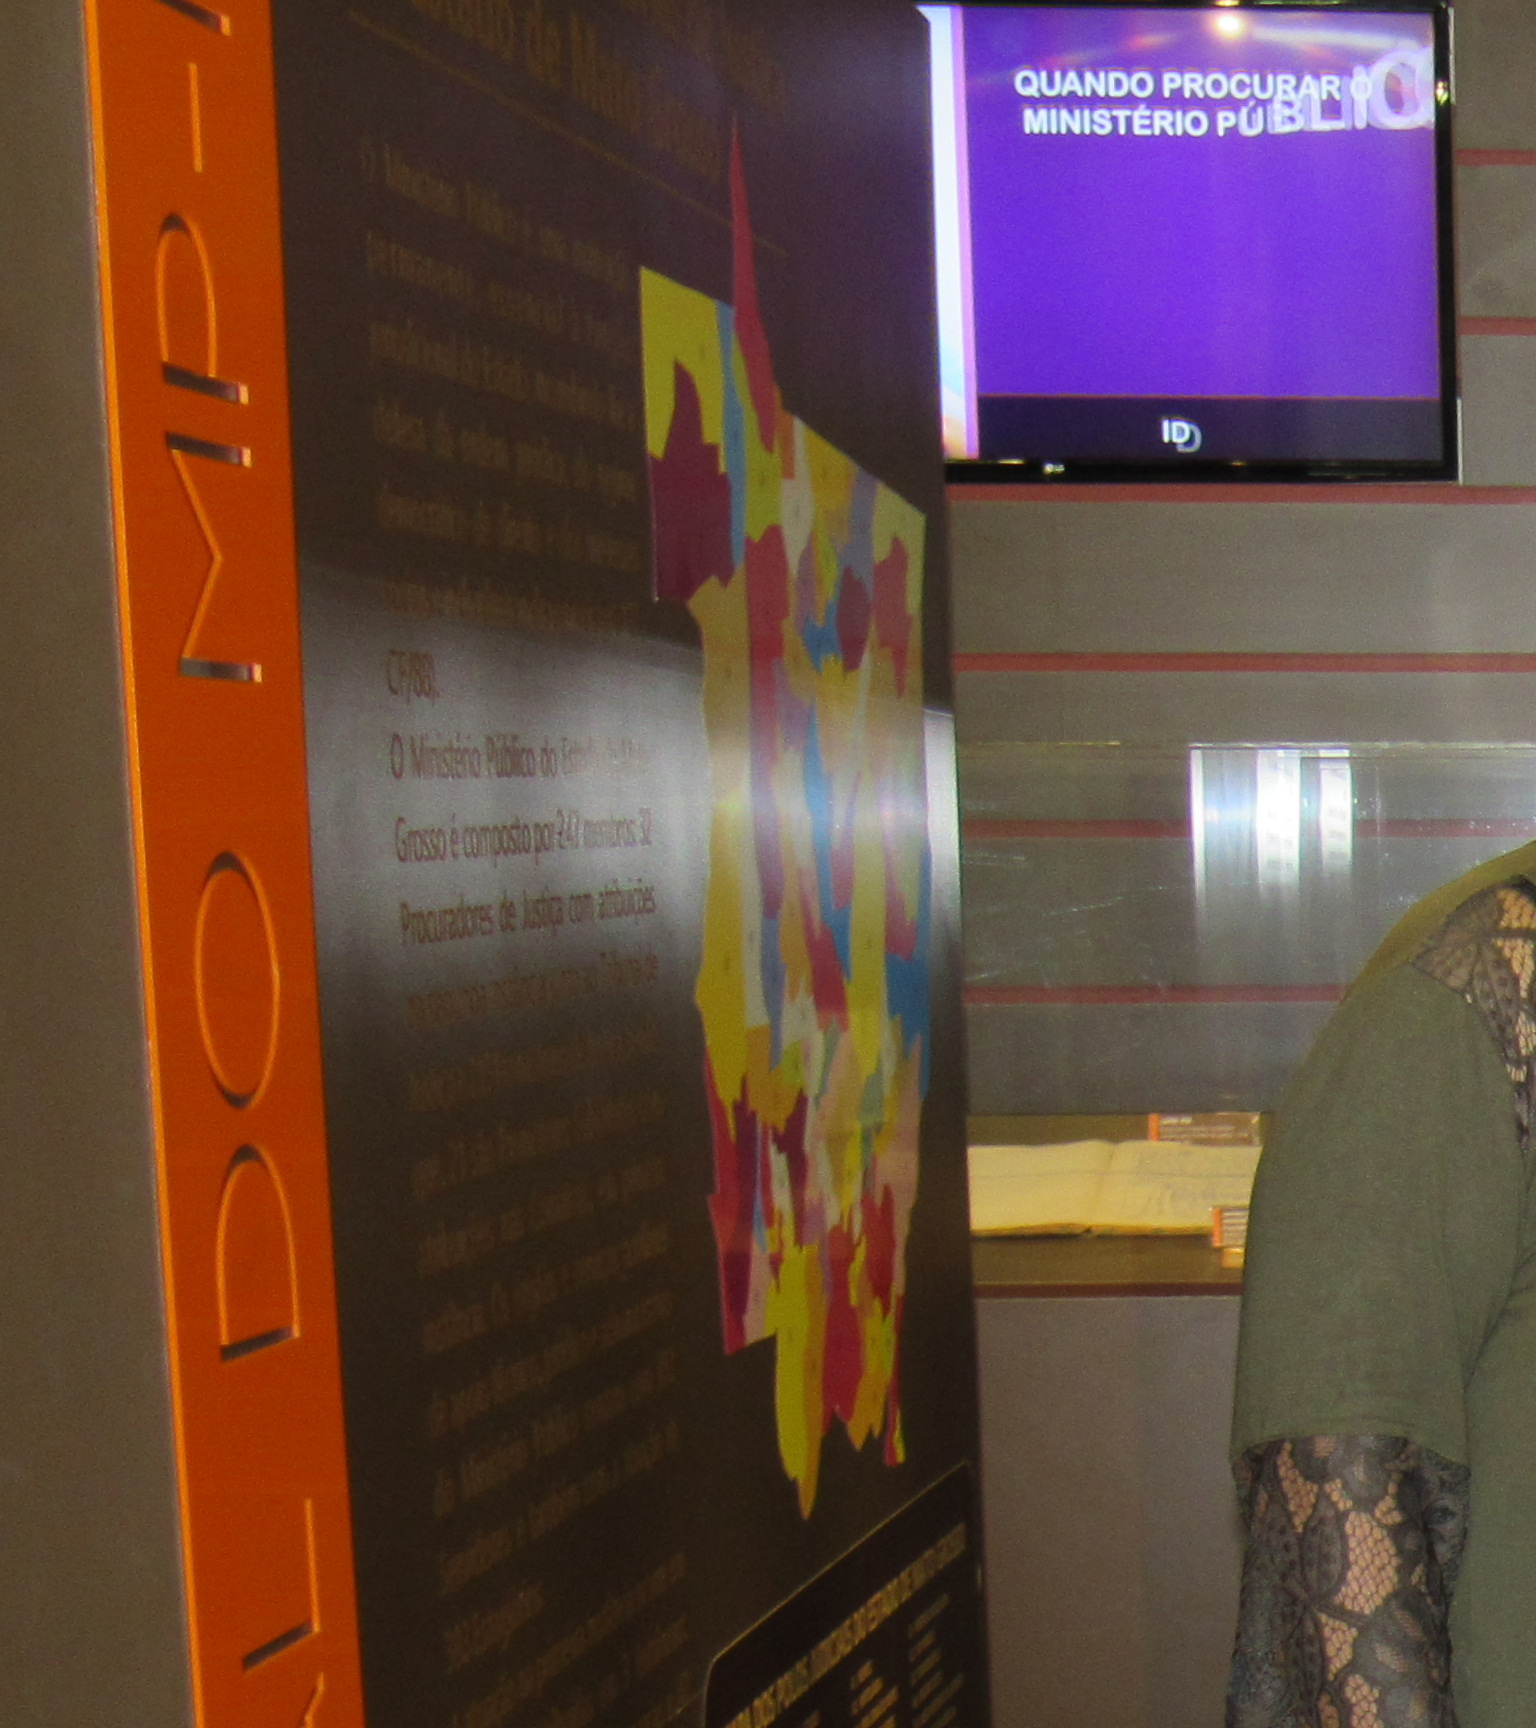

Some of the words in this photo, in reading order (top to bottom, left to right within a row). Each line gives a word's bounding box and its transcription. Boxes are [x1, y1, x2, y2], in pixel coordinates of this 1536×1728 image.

[1013, 69, 1155, 98] QUANDO
[1162, 71, 1341, 101] PROCURAR
[1022, 103, 1210, 137] MINISTÉRIO
[155, 0, 262, 683] MP-
[390, 732, 404, 779] O
[409, 732, 482, 779] Ministério
[486, 733, 536, 779] Público
[540, 735, 558, 779] do
[395, 816, 447, 863] Grosso
[451, 812, 461, 860] é
[463, 814, 533, 868] composto
[533, 822, 556, 867] por
[401, 891, 495, 946] Procuradores
[499, 889, 517, 932] de
[195, 850, 302, 1363] DO
